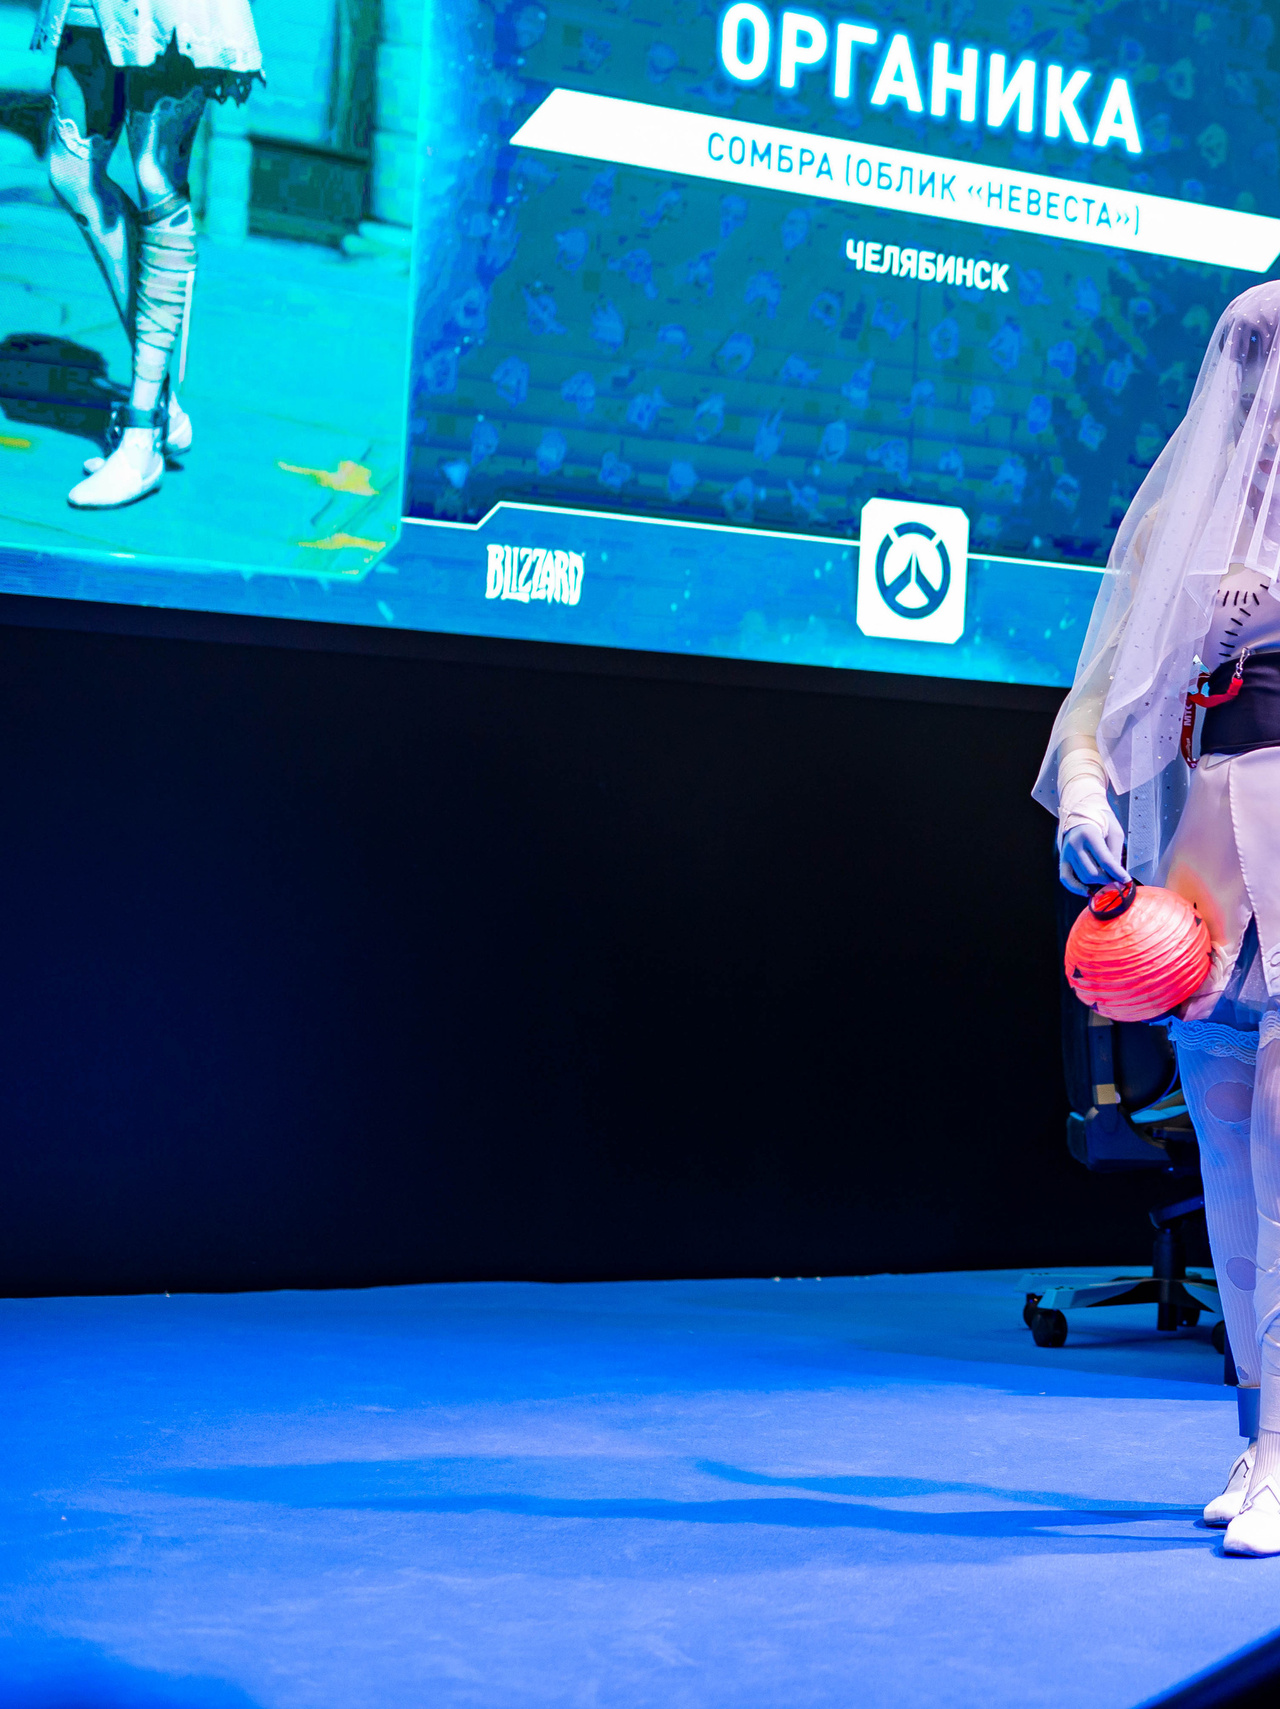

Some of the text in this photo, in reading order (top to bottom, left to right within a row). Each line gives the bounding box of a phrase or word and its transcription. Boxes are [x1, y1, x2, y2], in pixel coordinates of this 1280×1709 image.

[719, 2, 1145, 155] ОРГАНИКА
[706, 131, 837, 183] СОМБРА
[843, 239, 1012, 293] ЧЕЛЯБИНСК
[484, 544, 587, 606] BLIZZARD
